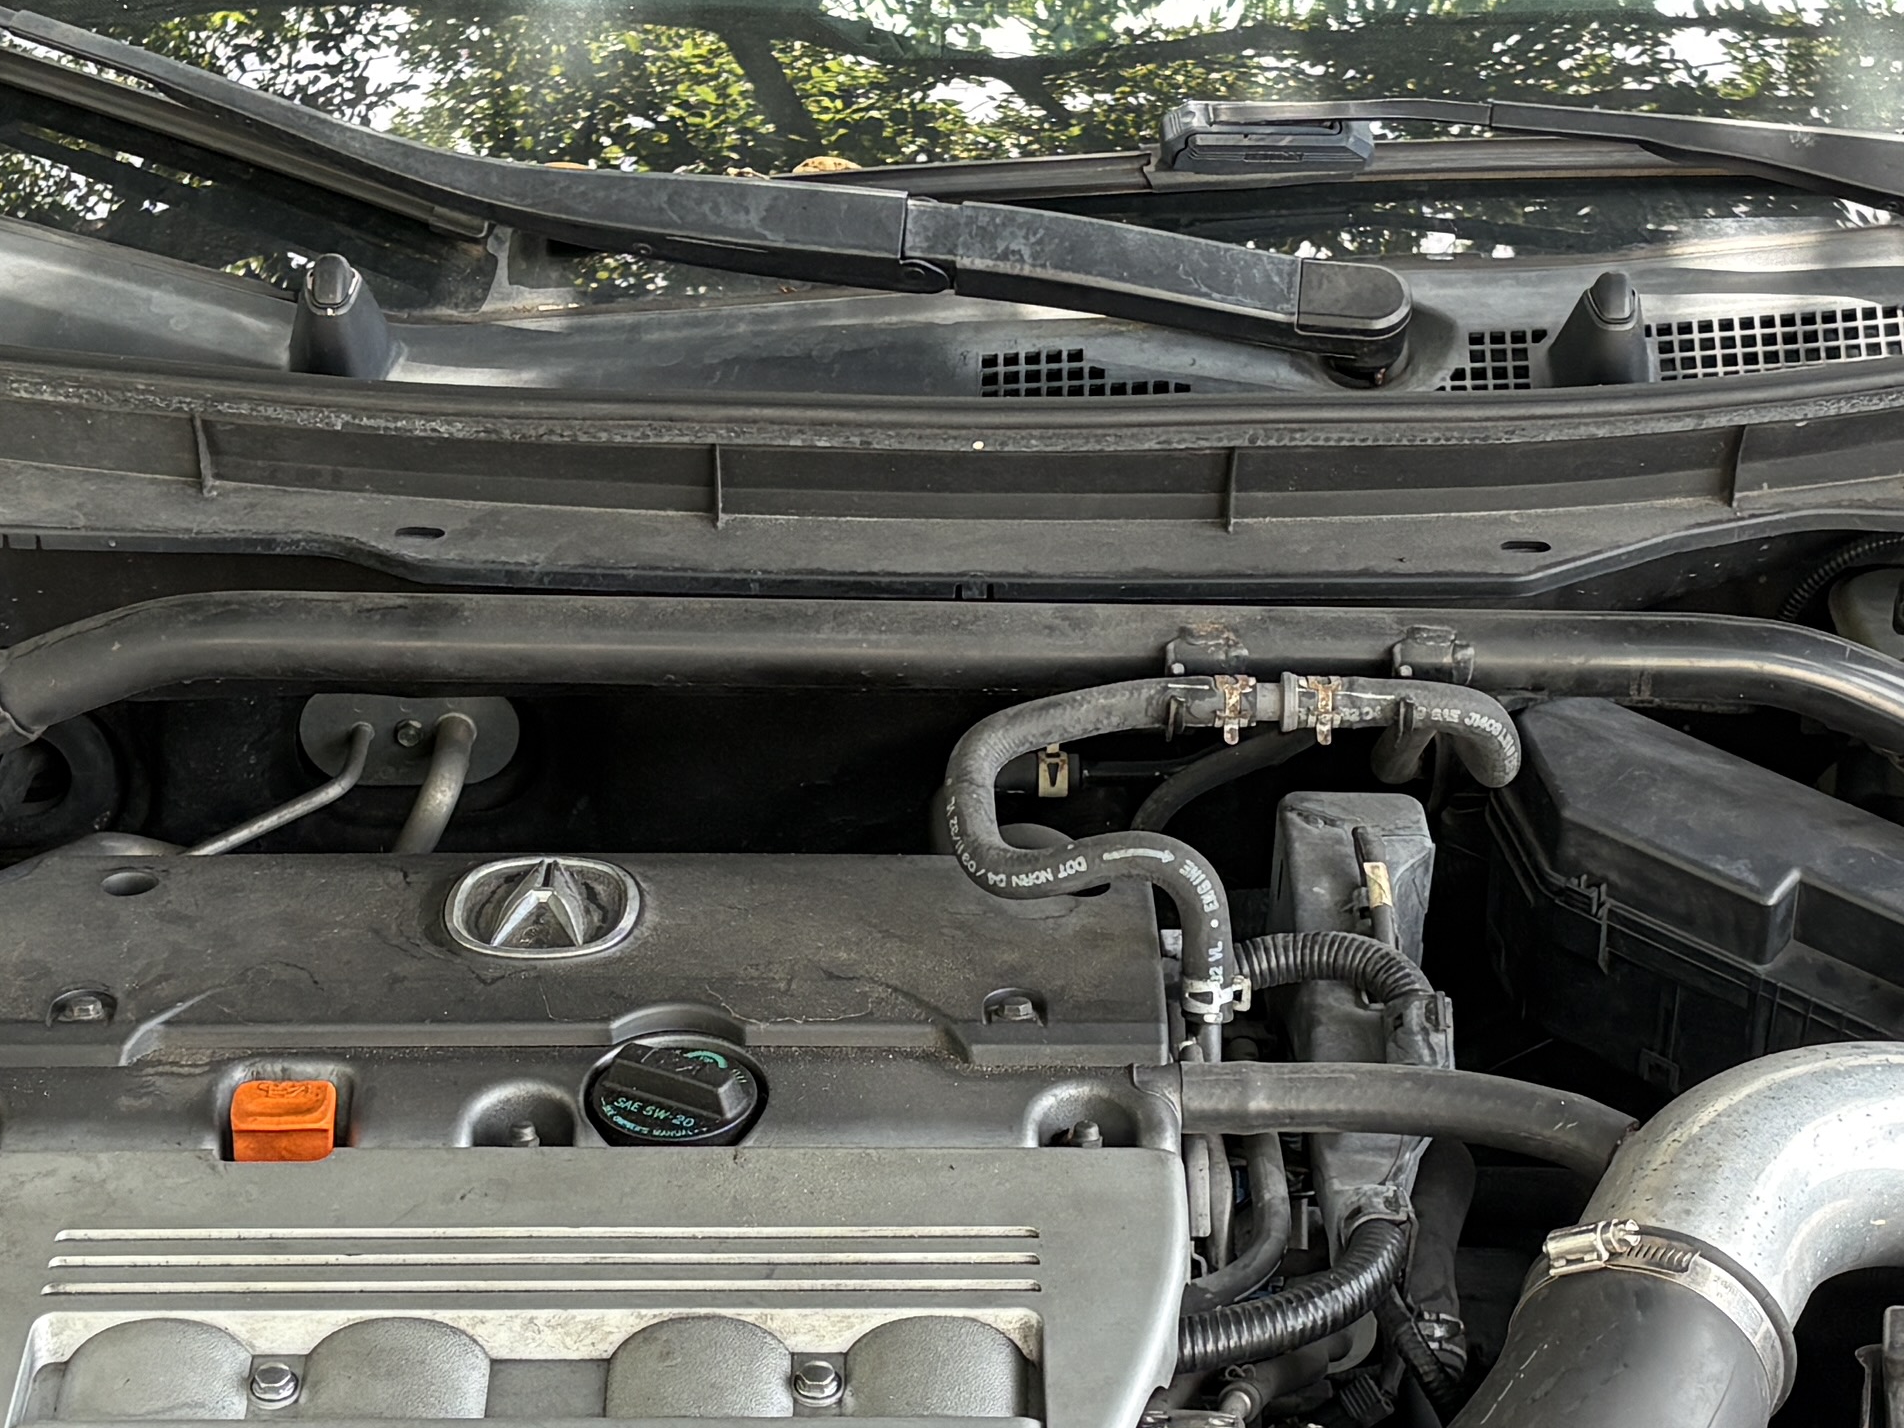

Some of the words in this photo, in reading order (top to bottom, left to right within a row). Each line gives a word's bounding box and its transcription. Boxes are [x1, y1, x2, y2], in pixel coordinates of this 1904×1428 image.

[1057, 856, 1088, 879] DOT
[1179, 859, 1221, 913] ENGINE
[613, 1097, 643, 1113] SAE
[642, 1105, 695, 1128] 5W-20
